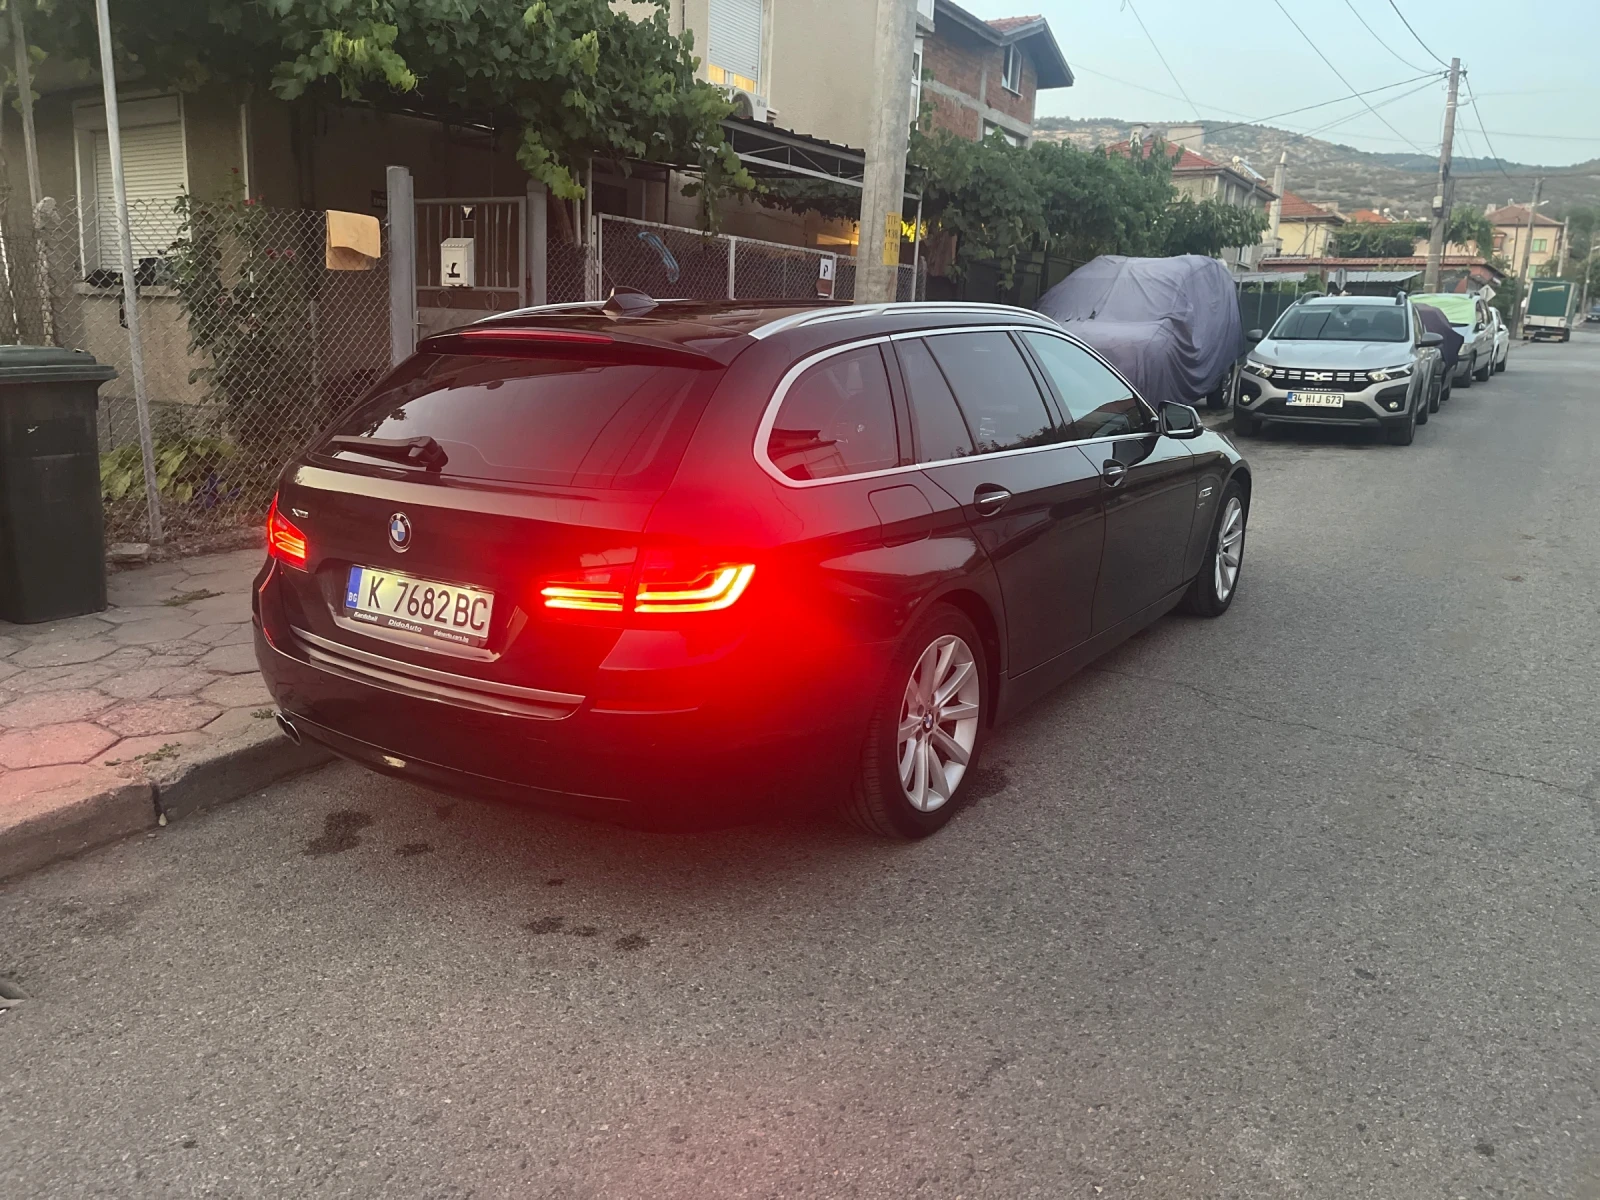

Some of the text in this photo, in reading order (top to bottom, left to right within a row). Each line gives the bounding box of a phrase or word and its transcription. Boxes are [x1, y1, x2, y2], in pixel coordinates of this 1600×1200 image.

[1292, 393, 1342, 405] 34 HIJ 673
[348, 591, 358, 603] BG
[368, 575, 385, 609] K
[387, 618, 423, 633] DidoAuto
